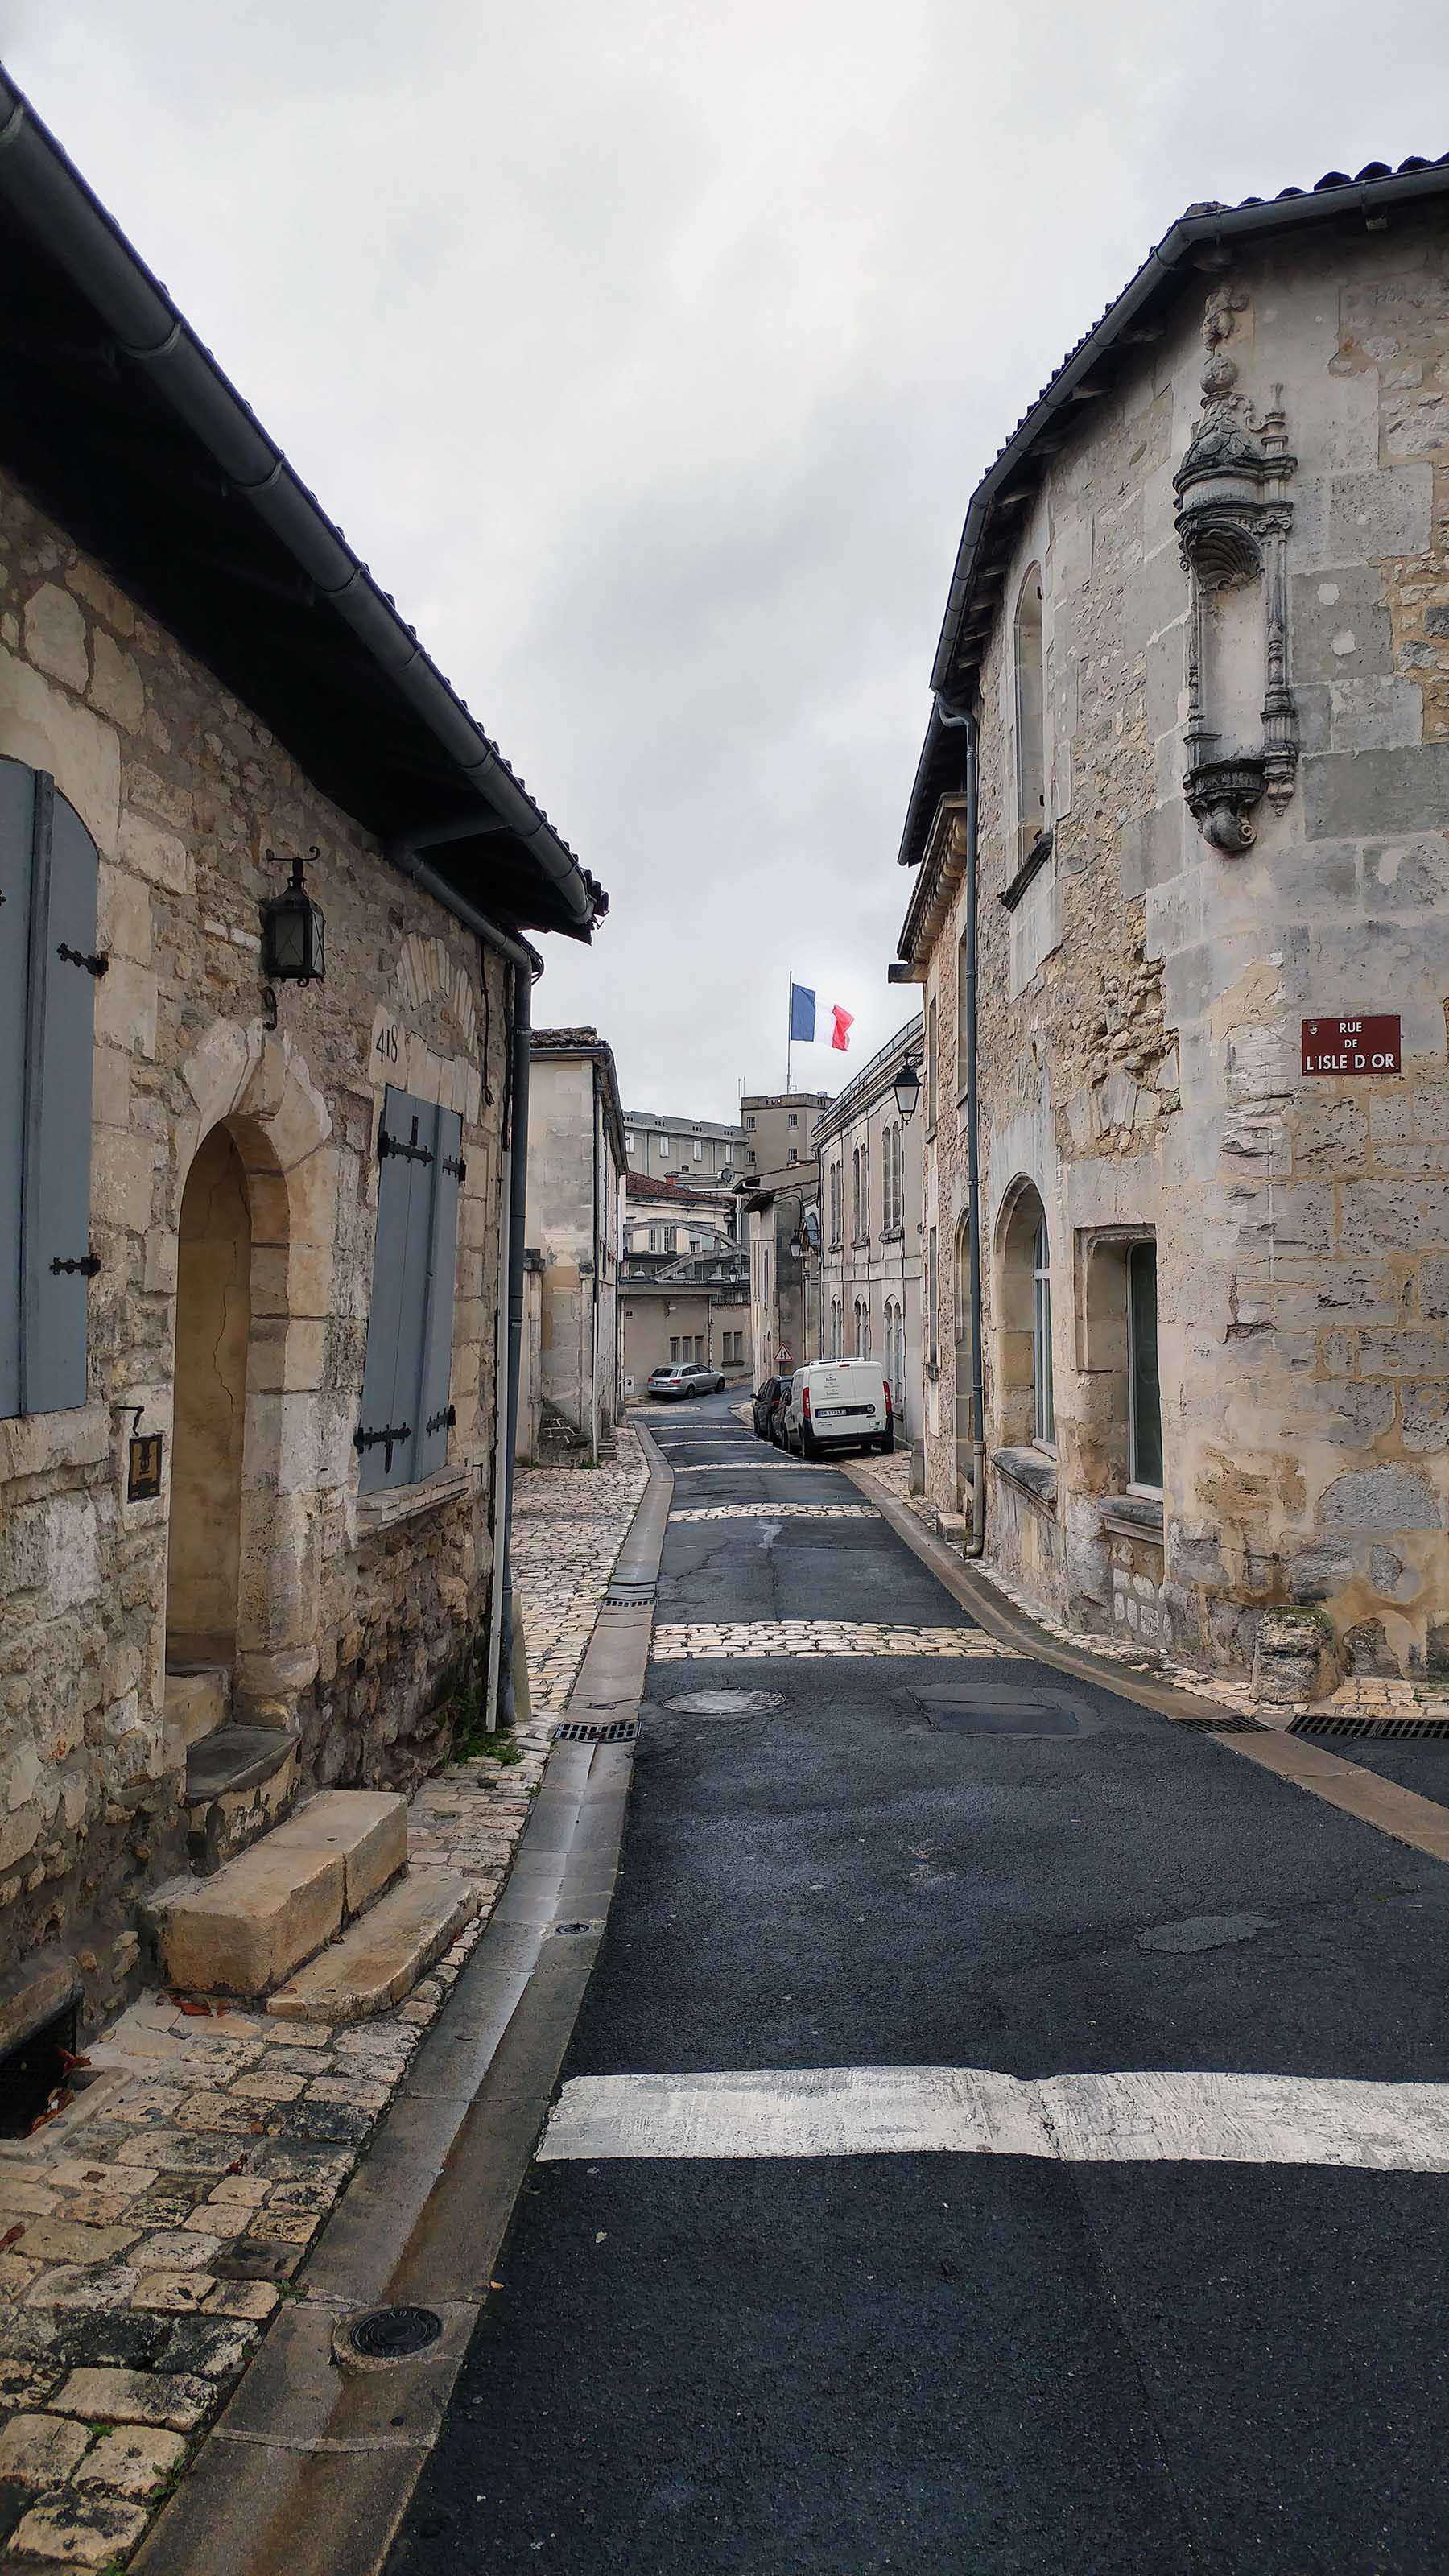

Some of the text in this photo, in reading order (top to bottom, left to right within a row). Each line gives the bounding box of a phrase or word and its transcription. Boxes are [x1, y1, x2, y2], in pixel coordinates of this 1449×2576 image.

[1339, 1022, 1363, 1034] RUE
[376, 1024, 398, 1063] 418
[1344, 1039, 1358, 1048] DE
[1307, 1053, 1395, 1071] L'ISLE D'OR
